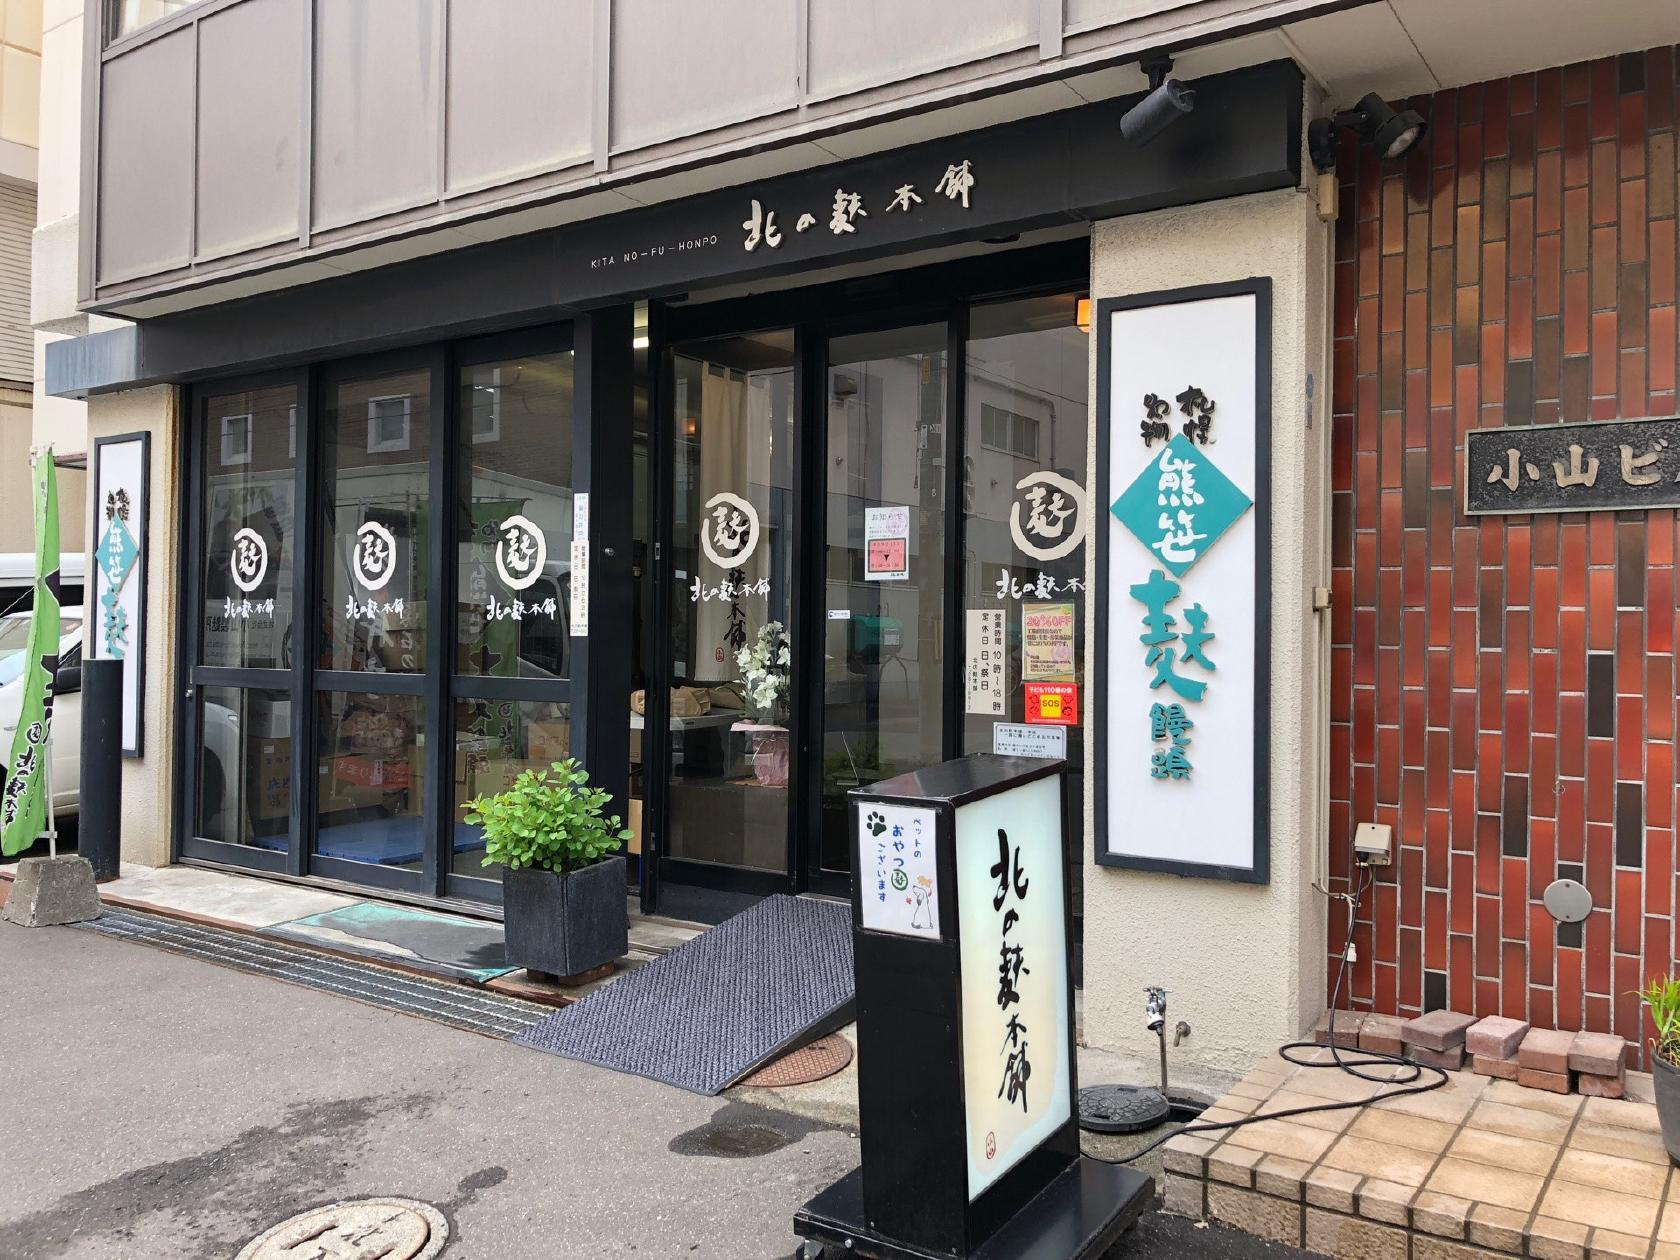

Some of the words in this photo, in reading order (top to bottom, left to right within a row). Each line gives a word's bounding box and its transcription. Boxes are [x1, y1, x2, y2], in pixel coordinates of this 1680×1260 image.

[591, 256, 615, 269] KITA
[1487, 438, 1680, 492] 小山ビ
[1152, 447, 1205, 564] 熊笹
[995, 568, 1087, 600] 北の麩本
[981, 613, 989, 645] 定休日
[994, 613, 1002, 645] 営業時間
[1042, 699, 1060, 708] SOS
[892, 824, 905, 868] おやつ
[913, 819, 922, 858] ペットの
